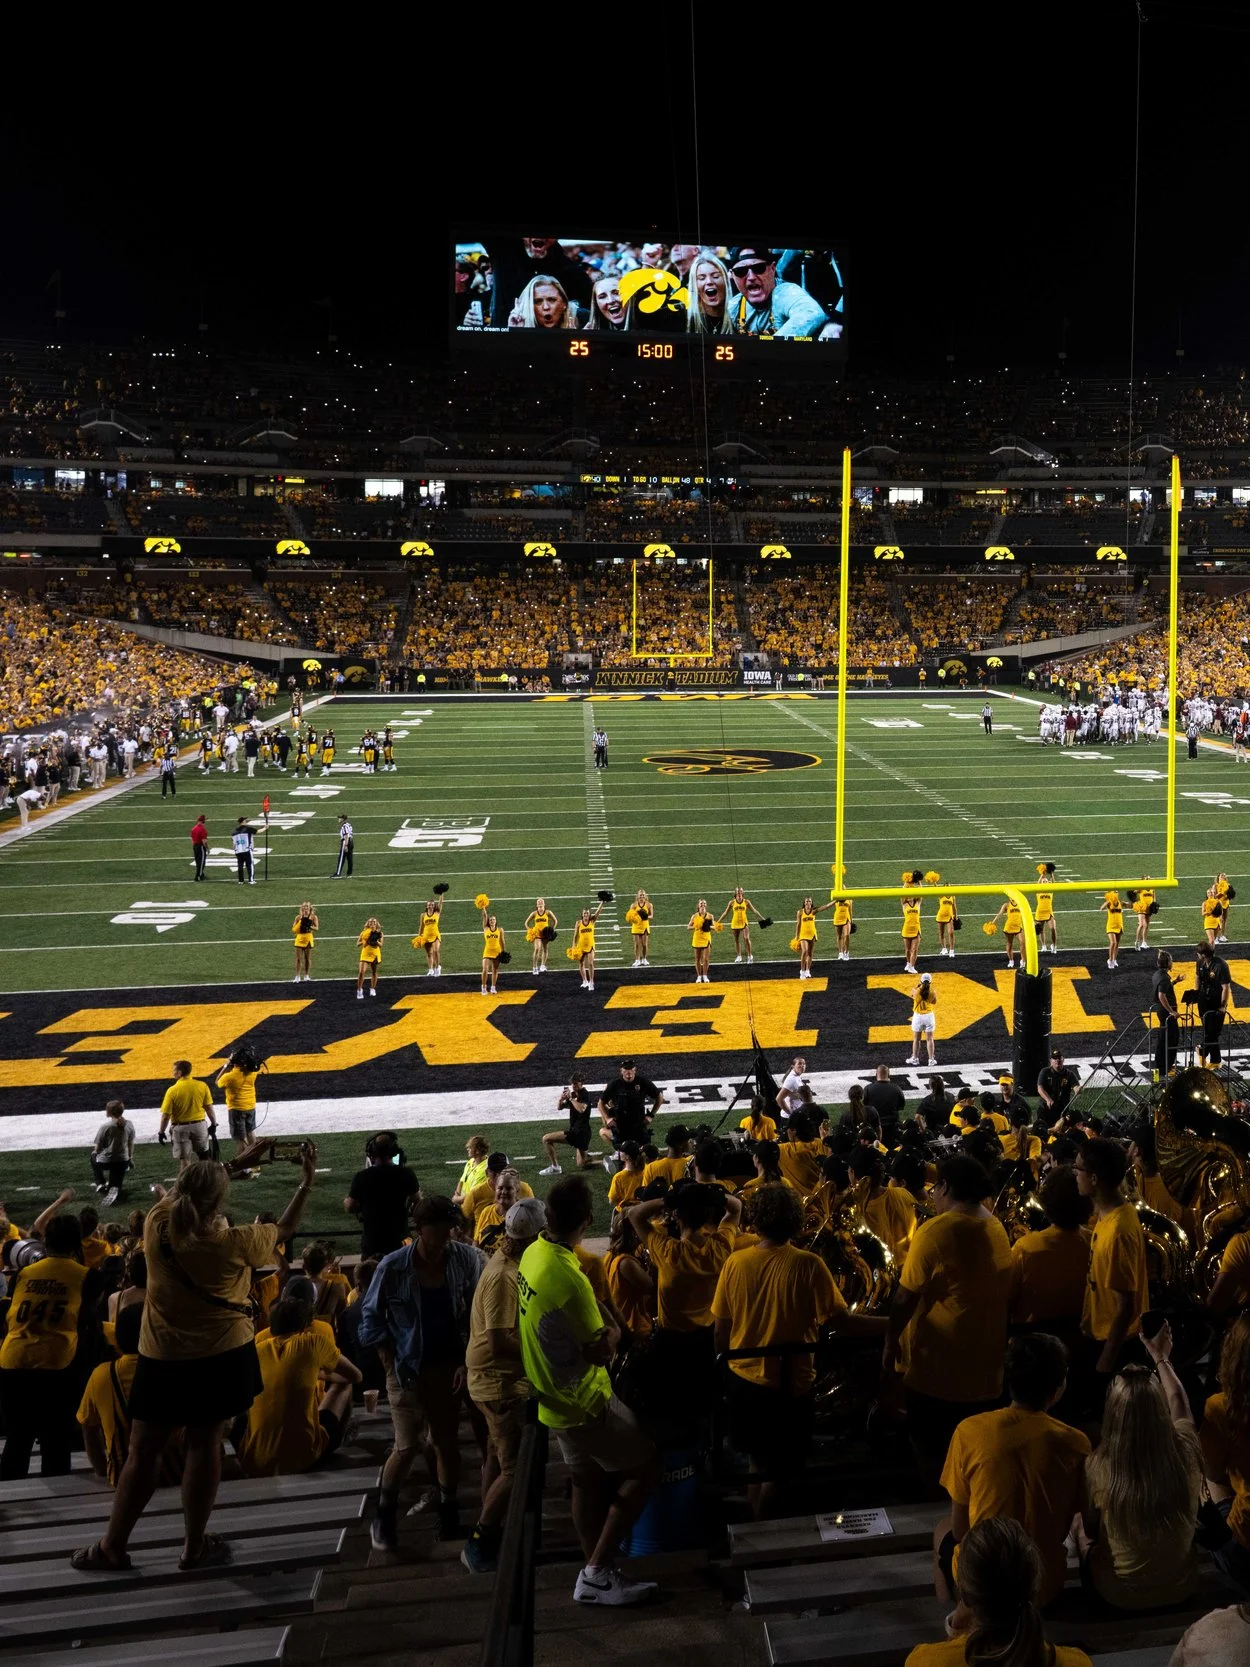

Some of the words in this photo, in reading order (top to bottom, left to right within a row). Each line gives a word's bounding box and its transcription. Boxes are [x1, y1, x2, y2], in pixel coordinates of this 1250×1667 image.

[570, 340, 589, 356] 25
[637, 343, 673, 358] 15:00
[715, 345, 734, 361] 25
[595, 671, 664, 686] KINNICK
[668, 670, 738, 685] TADIUM
[743, 671, 772, 680] IOWA
[325, 739, 333, 747] 71
[16, 1300, 69, 1322] 045
[662, 1463, 697, 1483] RADE
